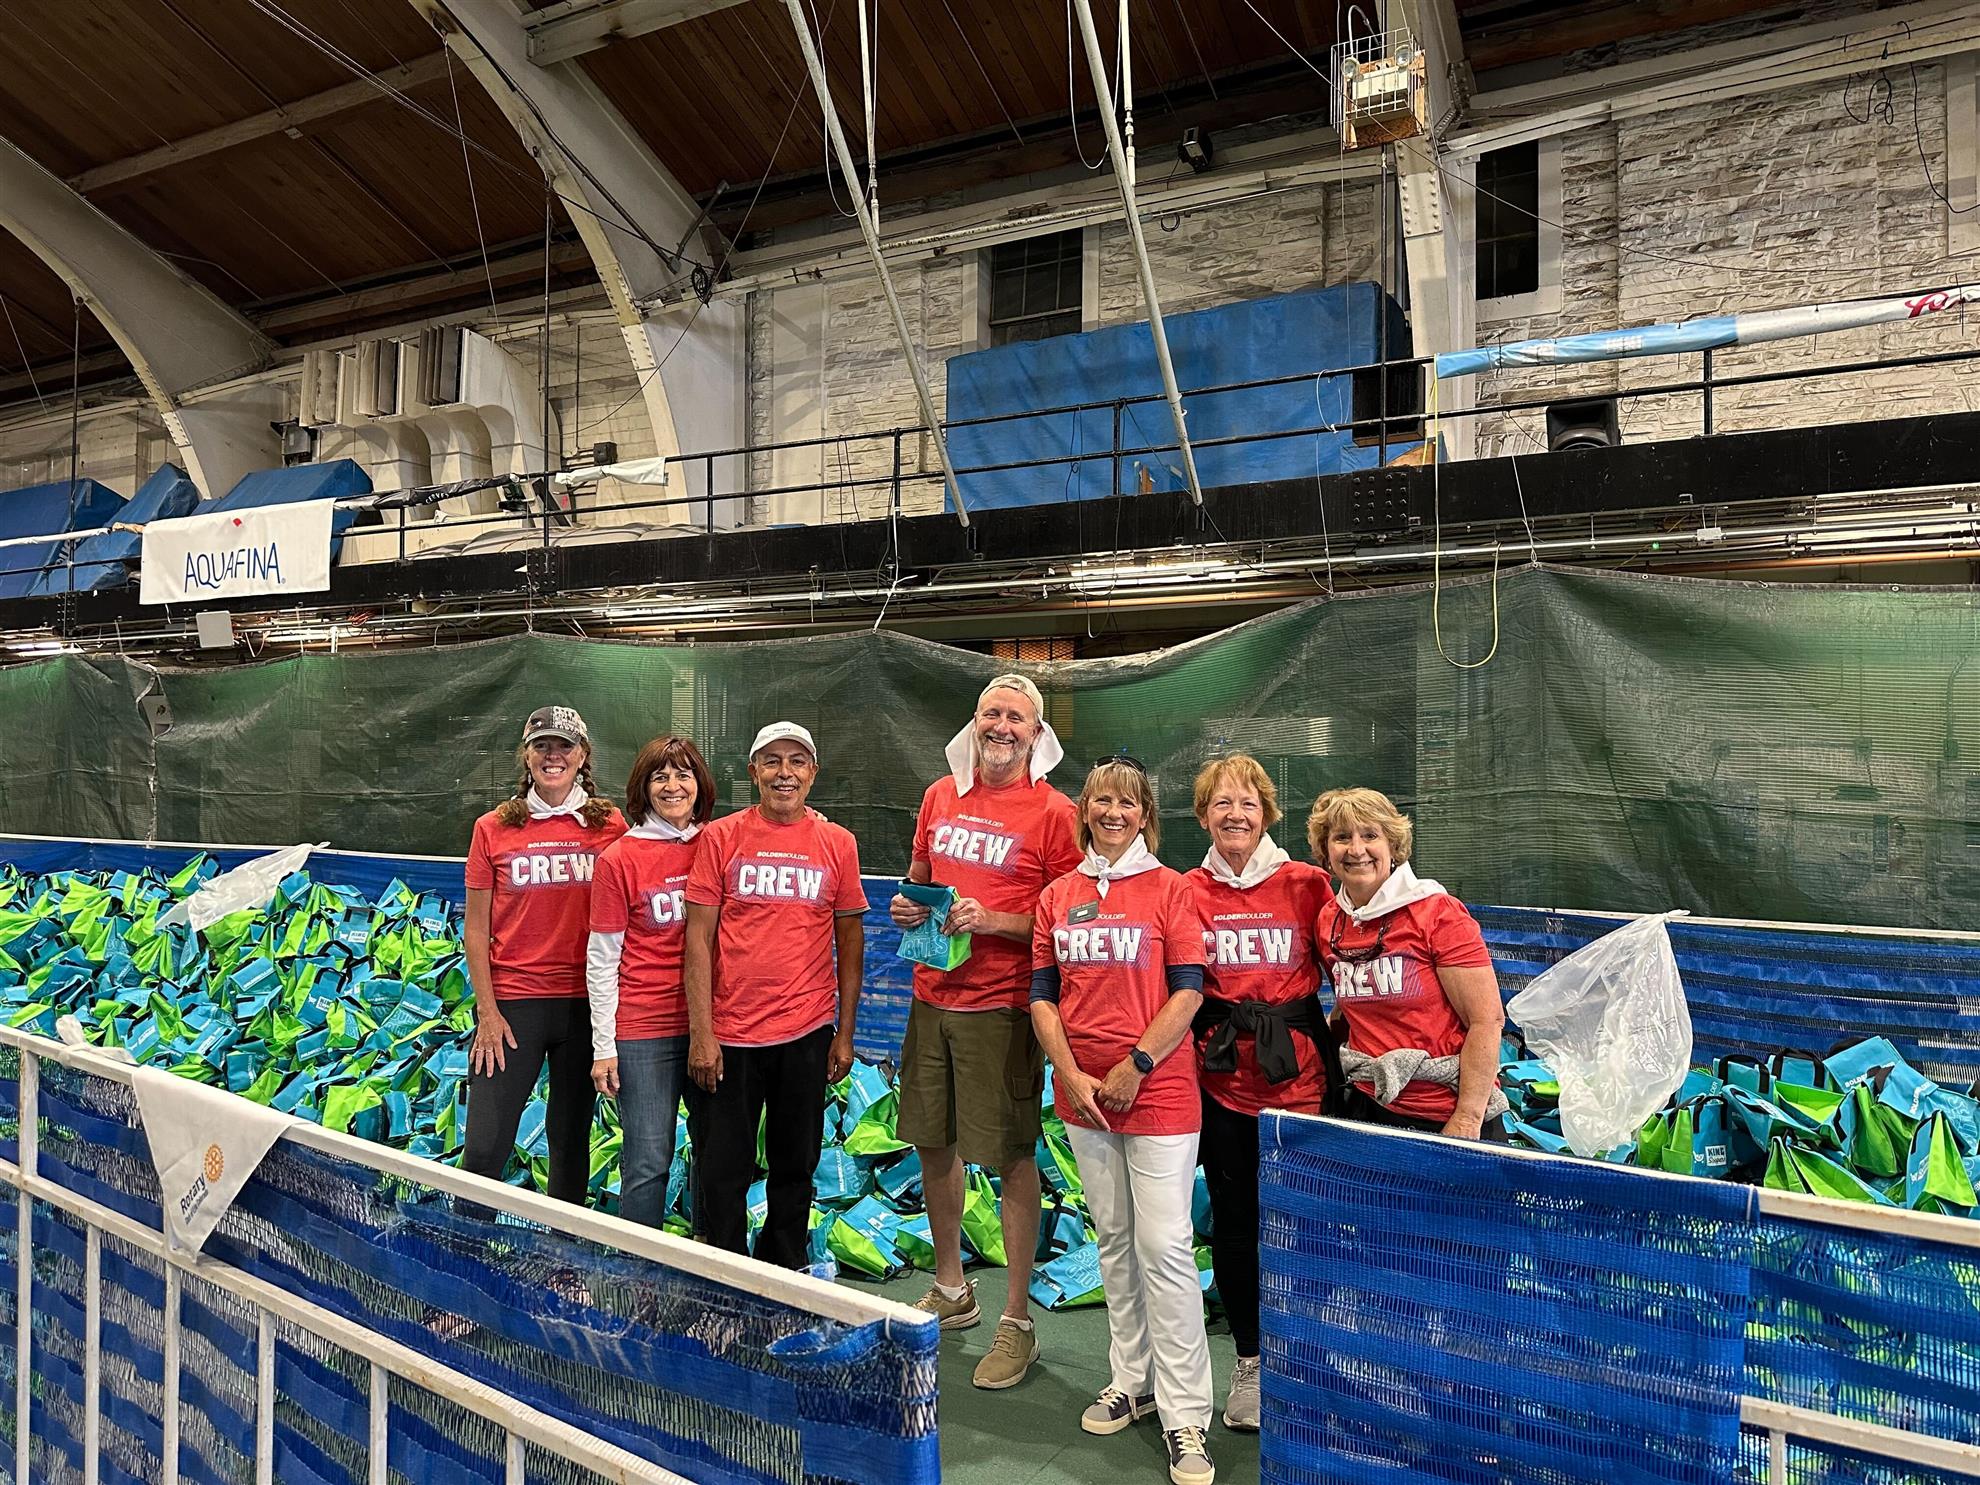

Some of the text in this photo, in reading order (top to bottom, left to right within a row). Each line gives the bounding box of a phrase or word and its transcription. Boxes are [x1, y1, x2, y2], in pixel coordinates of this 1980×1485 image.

[184, 542, 281, 593] AQUAFINA
[933, 825, 1014, 867] CREW
[511, 853, 595, 886] CREW
[738, 864, 823, 899] CREW
[651, 890, 687, 924] CR
[1213, 912, 1273, 922] BOLDERBOULDER
[1053, 927, 1142, 962] CREW
[1202, 928, 1293, 965] CREW
[181, 1172, 205, 1215] Rotary
